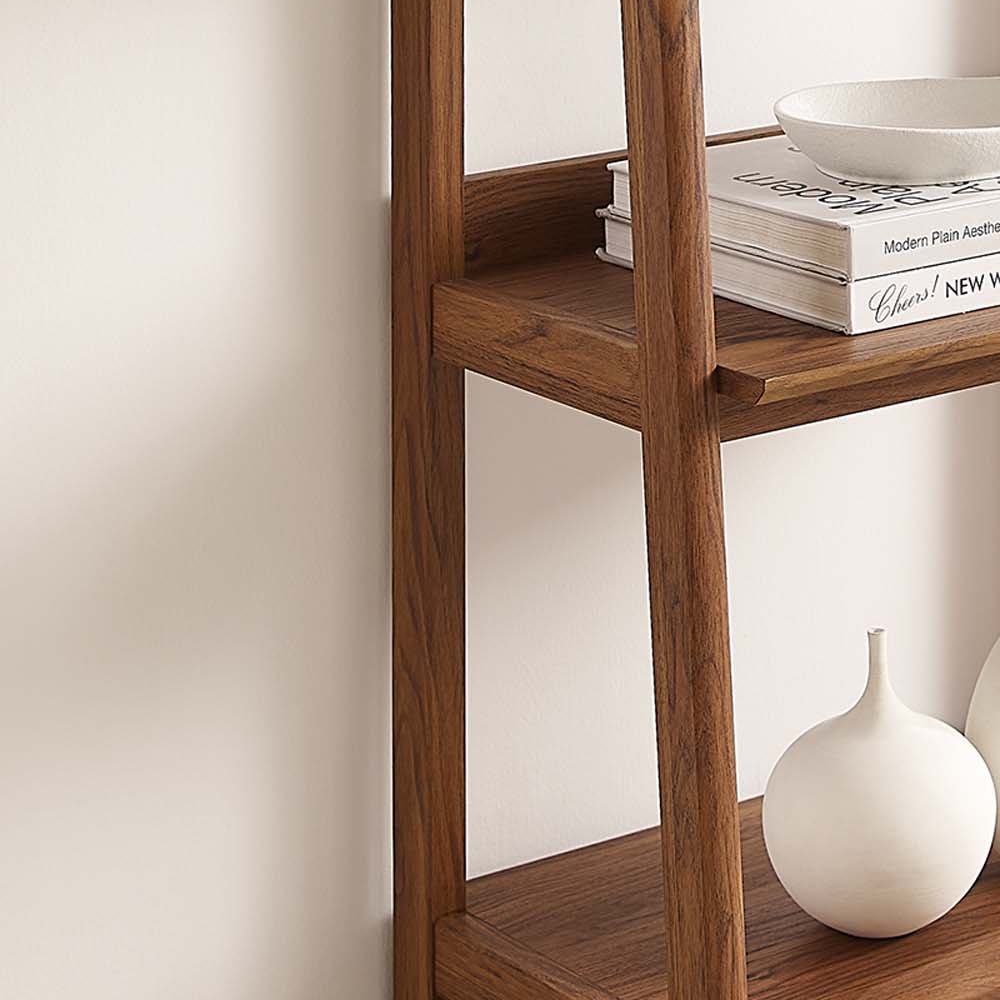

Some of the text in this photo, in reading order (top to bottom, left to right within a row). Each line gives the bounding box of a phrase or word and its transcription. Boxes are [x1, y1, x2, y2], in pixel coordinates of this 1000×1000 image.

[733, 172, 898, 215] Modern
[884, 235, 929, 255] Modern
[931, 230, 960, 246] Plain
[868, 273, 940, 323] Cheers!
[945, 274, 985, 298] NEW
